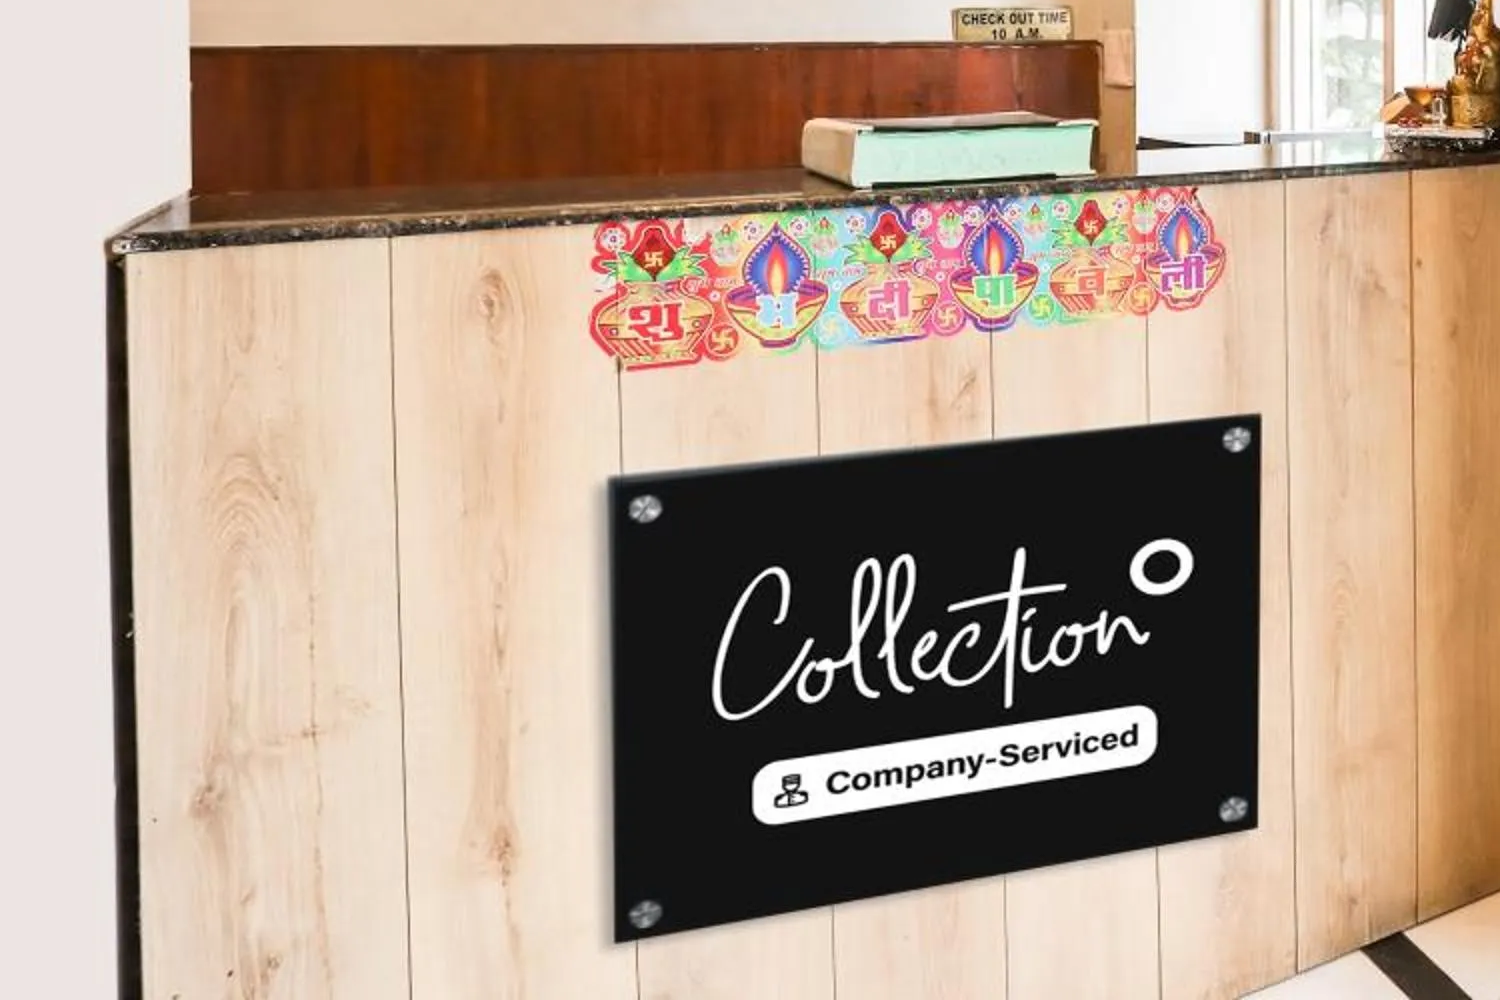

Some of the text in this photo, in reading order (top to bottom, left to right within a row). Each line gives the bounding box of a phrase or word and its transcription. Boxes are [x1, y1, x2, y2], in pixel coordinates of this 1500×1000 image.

[962, 11, 1068, 25] CHECK OUT TIME
[992, 28, 1007, 40] 10
[711, 547, 1151, 722] Collection
[825, 723, 1140, 796] Company-Serviced
